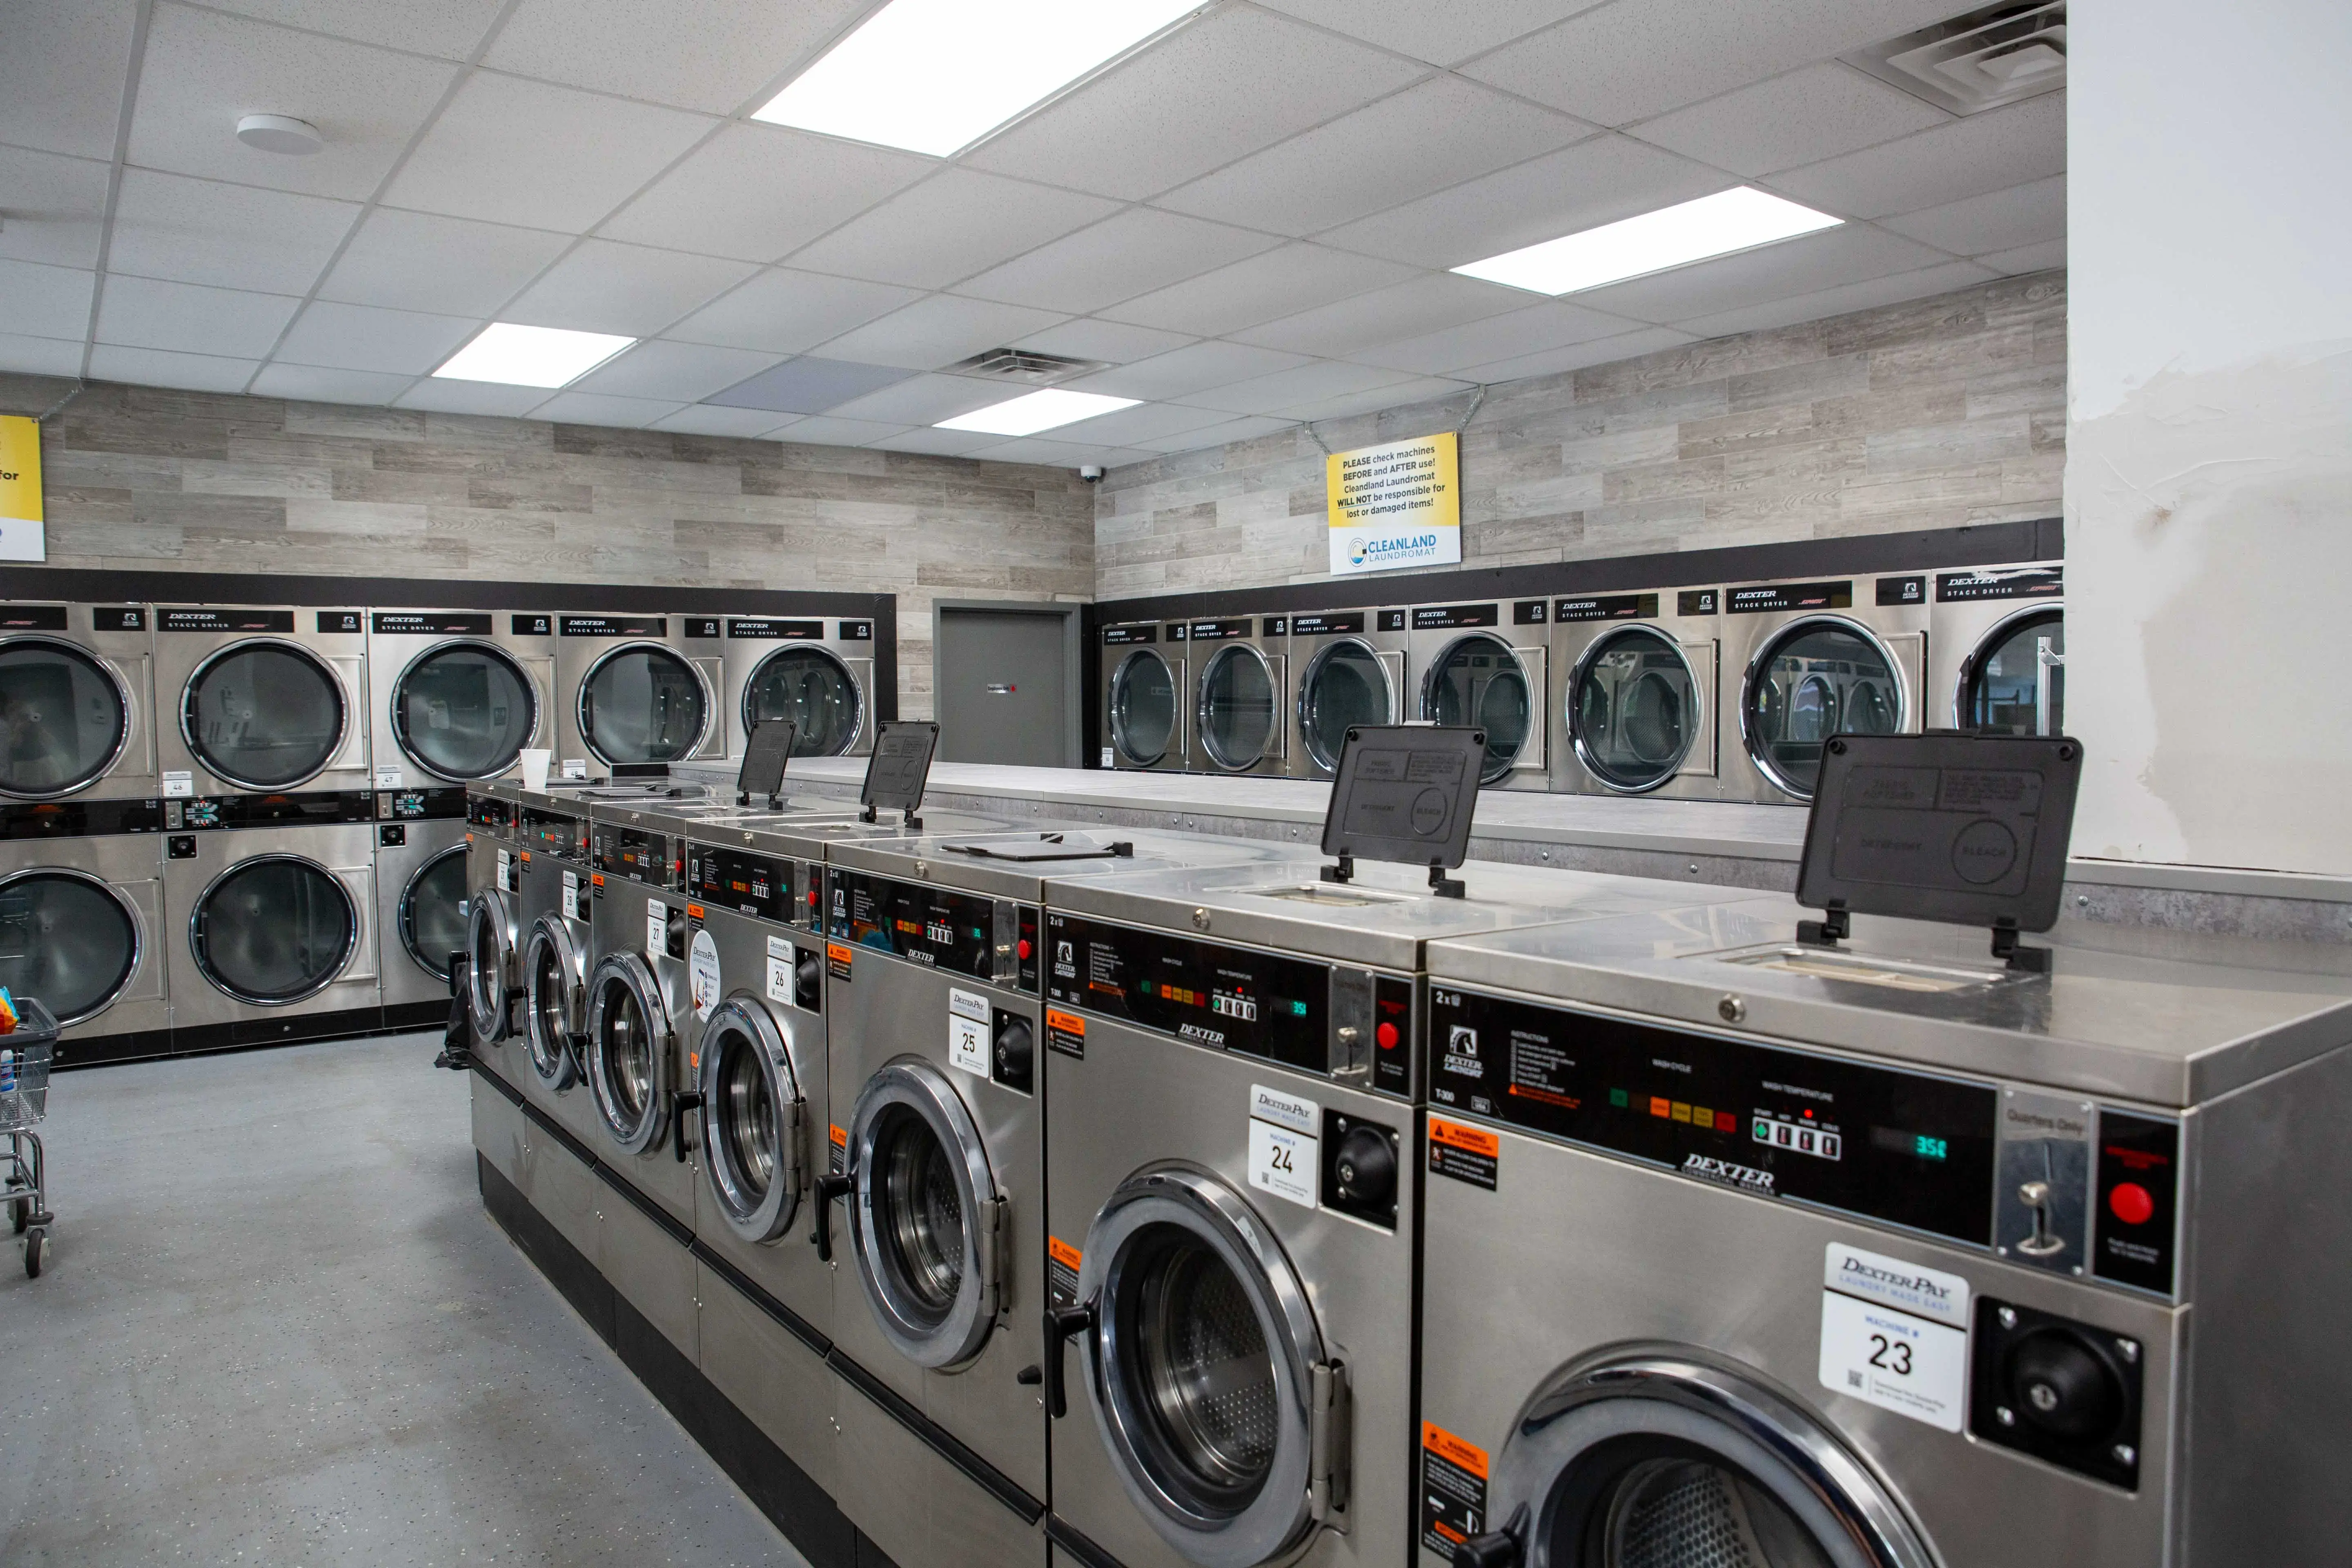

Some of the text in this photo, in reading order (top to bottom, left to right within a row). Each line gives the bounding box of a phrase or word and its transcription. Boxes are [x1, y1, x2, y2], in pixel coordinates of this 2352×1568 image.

[1343, 446, 1435, 468] PLEASE check machines
[1343, 458, 1435, 481] BEFORE and AFTER use!
[1344, 472, 1435, 493] Cleandland Laundromat
[1337, 483, 1445, 508] WILL NOT be responsible for
[1347, 509, 1359, 518] lost
[1371, 503, 1406, 517] damaged
[1408, 498, 1433, 509] items!
[1368, 535, 1436, 553] CLEANLAND
[1369, 548, 1436, 562] LAUNDROMAT
[1947, 577, 1998, 586] DEXTER
[1735, 590, 1776, 599] DEXTER
[741, 904, 757, 914] DEXTER
[654, 927, 659, 940] 27
[693, 947, 715, 961] DEXTERPAY
[908, 949, 934, 963] DEXTER
[1055, 962, 1076, 973] DEXTER
[776, 971, 784, 987] 26
[954, 994, 984, 1010] DEXTERPAY
[963, 1032, 975, 1053] 25
[1180, 1023, 1225, 1044] DEXTER
[1444, 1054, 1483, 1070] DEXTER
[1259, 1094, 1310, 1117] DEXTERPAY
[2007, 1108, 2085, 1135] Quarters Only
[1270, 1132, 1291, 1145] MACHINE
[1272, 1145, 1293, 1174] 24
[1684, 1153, 1775, 1187] DEXTER
[1843, 1256, 1951, 1298] DEXTERPAY
[1839, 1274, 1950, 1312] LAUNDRY MADE EASY
[1865, 1314, 1909, 1335] MACHINE
[1869, 1334, 1912, 1376] 23
